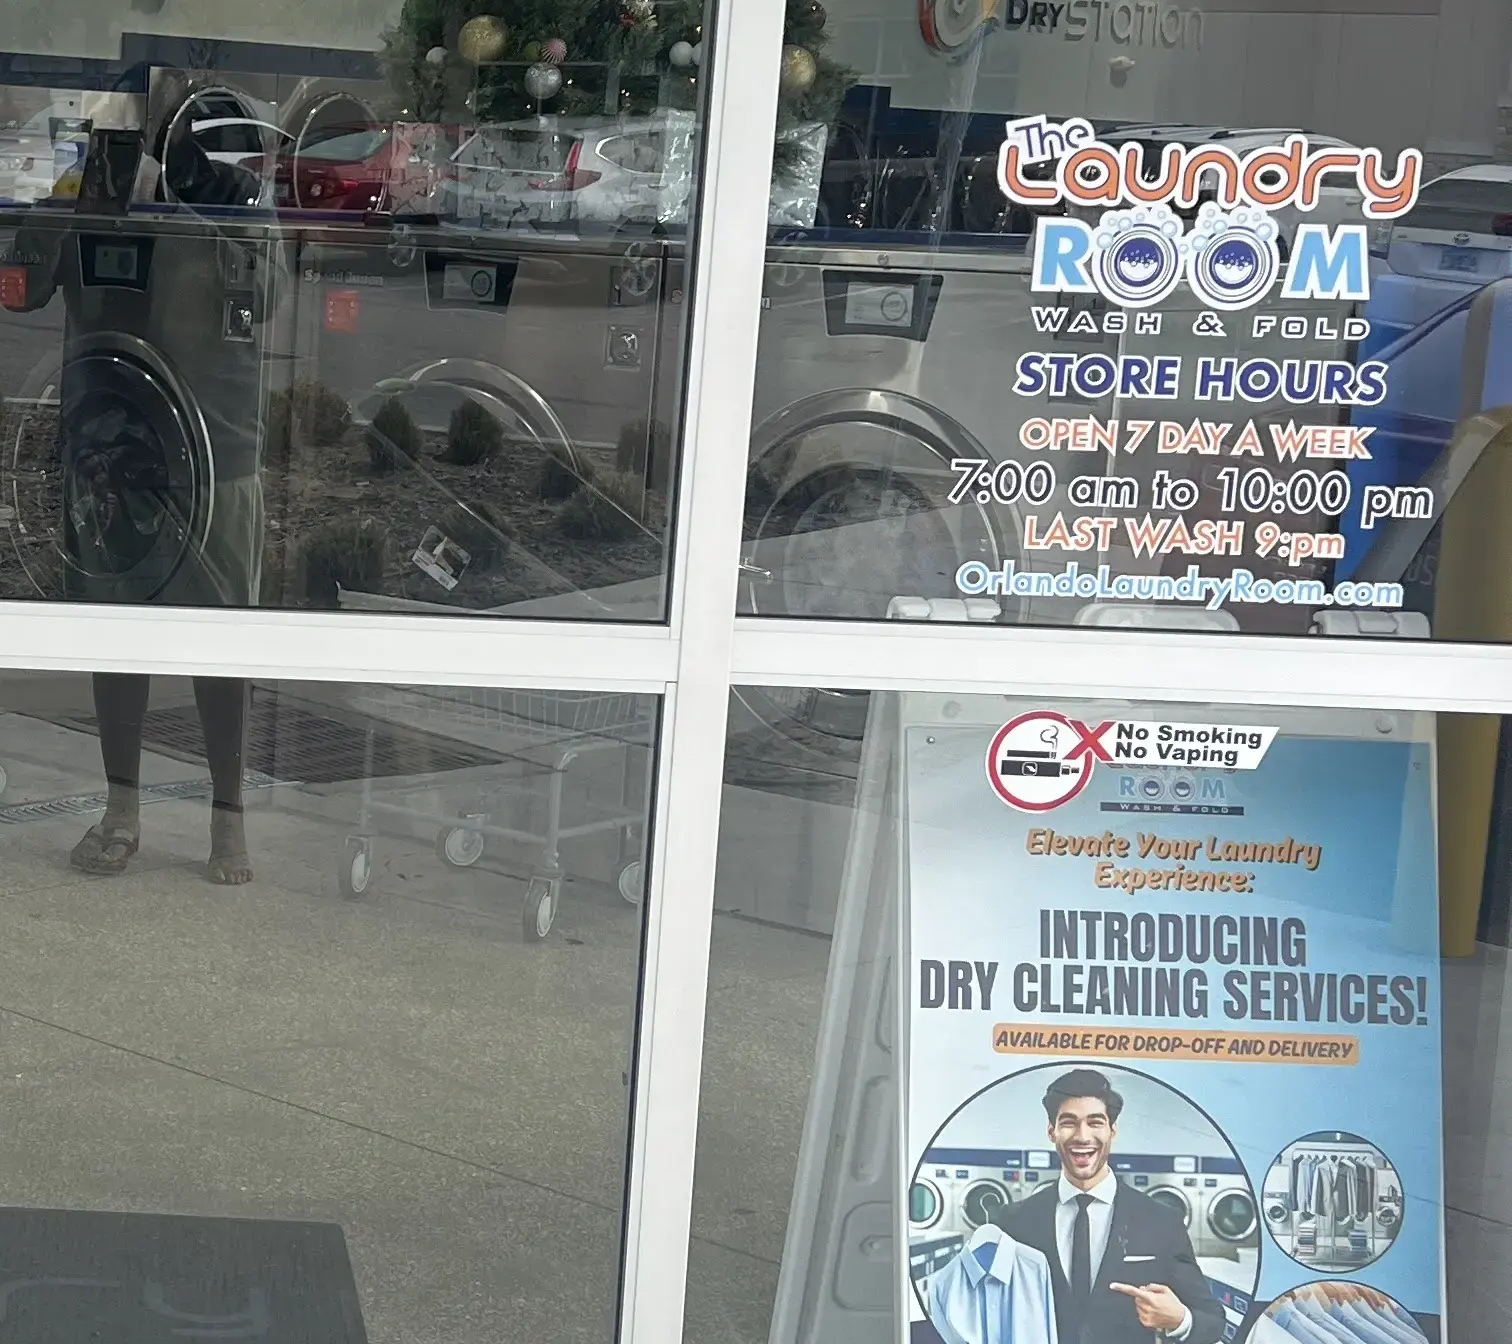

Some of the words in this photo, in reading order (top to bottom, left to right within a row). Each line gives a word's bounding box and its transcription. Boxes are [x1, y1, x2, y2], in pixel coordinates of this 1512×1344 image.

[1012, 119, 1091, 160] The
[1001, 139, 1419, 215] Laundry
[1035, 218, 1370, 307] ROOM
[1032, 307, 1162, 335] WASH
[1193, 312, 1227, 337] &
[1253, 315, 1370, 341] FOLD
[1013, 352, 1181, 400] STORE
[1194, 358, 1389, 405] HOURS
[1019, 415, 1118, 454] OPEN
[1123, 419, 1155, 454] 7
[1159, 416, 1231, 455] DAY
[1231, 417, 1265, 458] A
[1269, 423, 1377, 462] WEEK
[948, 458, 1055, 505] 7:00
[1068, 475, 1138, 509] am
[1152, 470, 1199, 510] to
[1216, 467, 1351, 518] 10:00
[1361, 484, 1434, 529] pm
[1023, 512, 1117, 551] LAST
[1124, 514, 1243, 559] WASH
[1254, 526, 1345, 566] 9:pm
[955, 560, 1404, 611] OrlandoLaundryRoom.com
[1115, 741, 1148, 758] No
[1156, 743, 1239, 766] Vaping
[1117, 723, 1149, 740] No
[1157, 724, 1263, 749] Smoking
[1119, 776, 1226, 802] ROOM
[1119, 803, 1162, 811] WASH
[1026, 828, 1129, 858] Elevate
[1136, 832, 1202, 861] Your
[1206, 835, 1322, 870] Laundry
[1093, 861, 1256, 895] Experience:
[1039, 908, 1307, 967] INTRODUCING
[919, 959, 998, 1011] DRY
[1013, 962, 1209, 1019] CLEANING
[1223, 970, 1428, 1026] SERVICES!
[996, 1030, 1091, 1052] AVAILABLE
[1094, 1034, 1129, 1053] FOR
[1133, 1035, 1225, 1056] DROP-OFF
[1227, 1038, 1266, 1056] AND
[1268, 1039, 1354, 1059] DELIVERY
